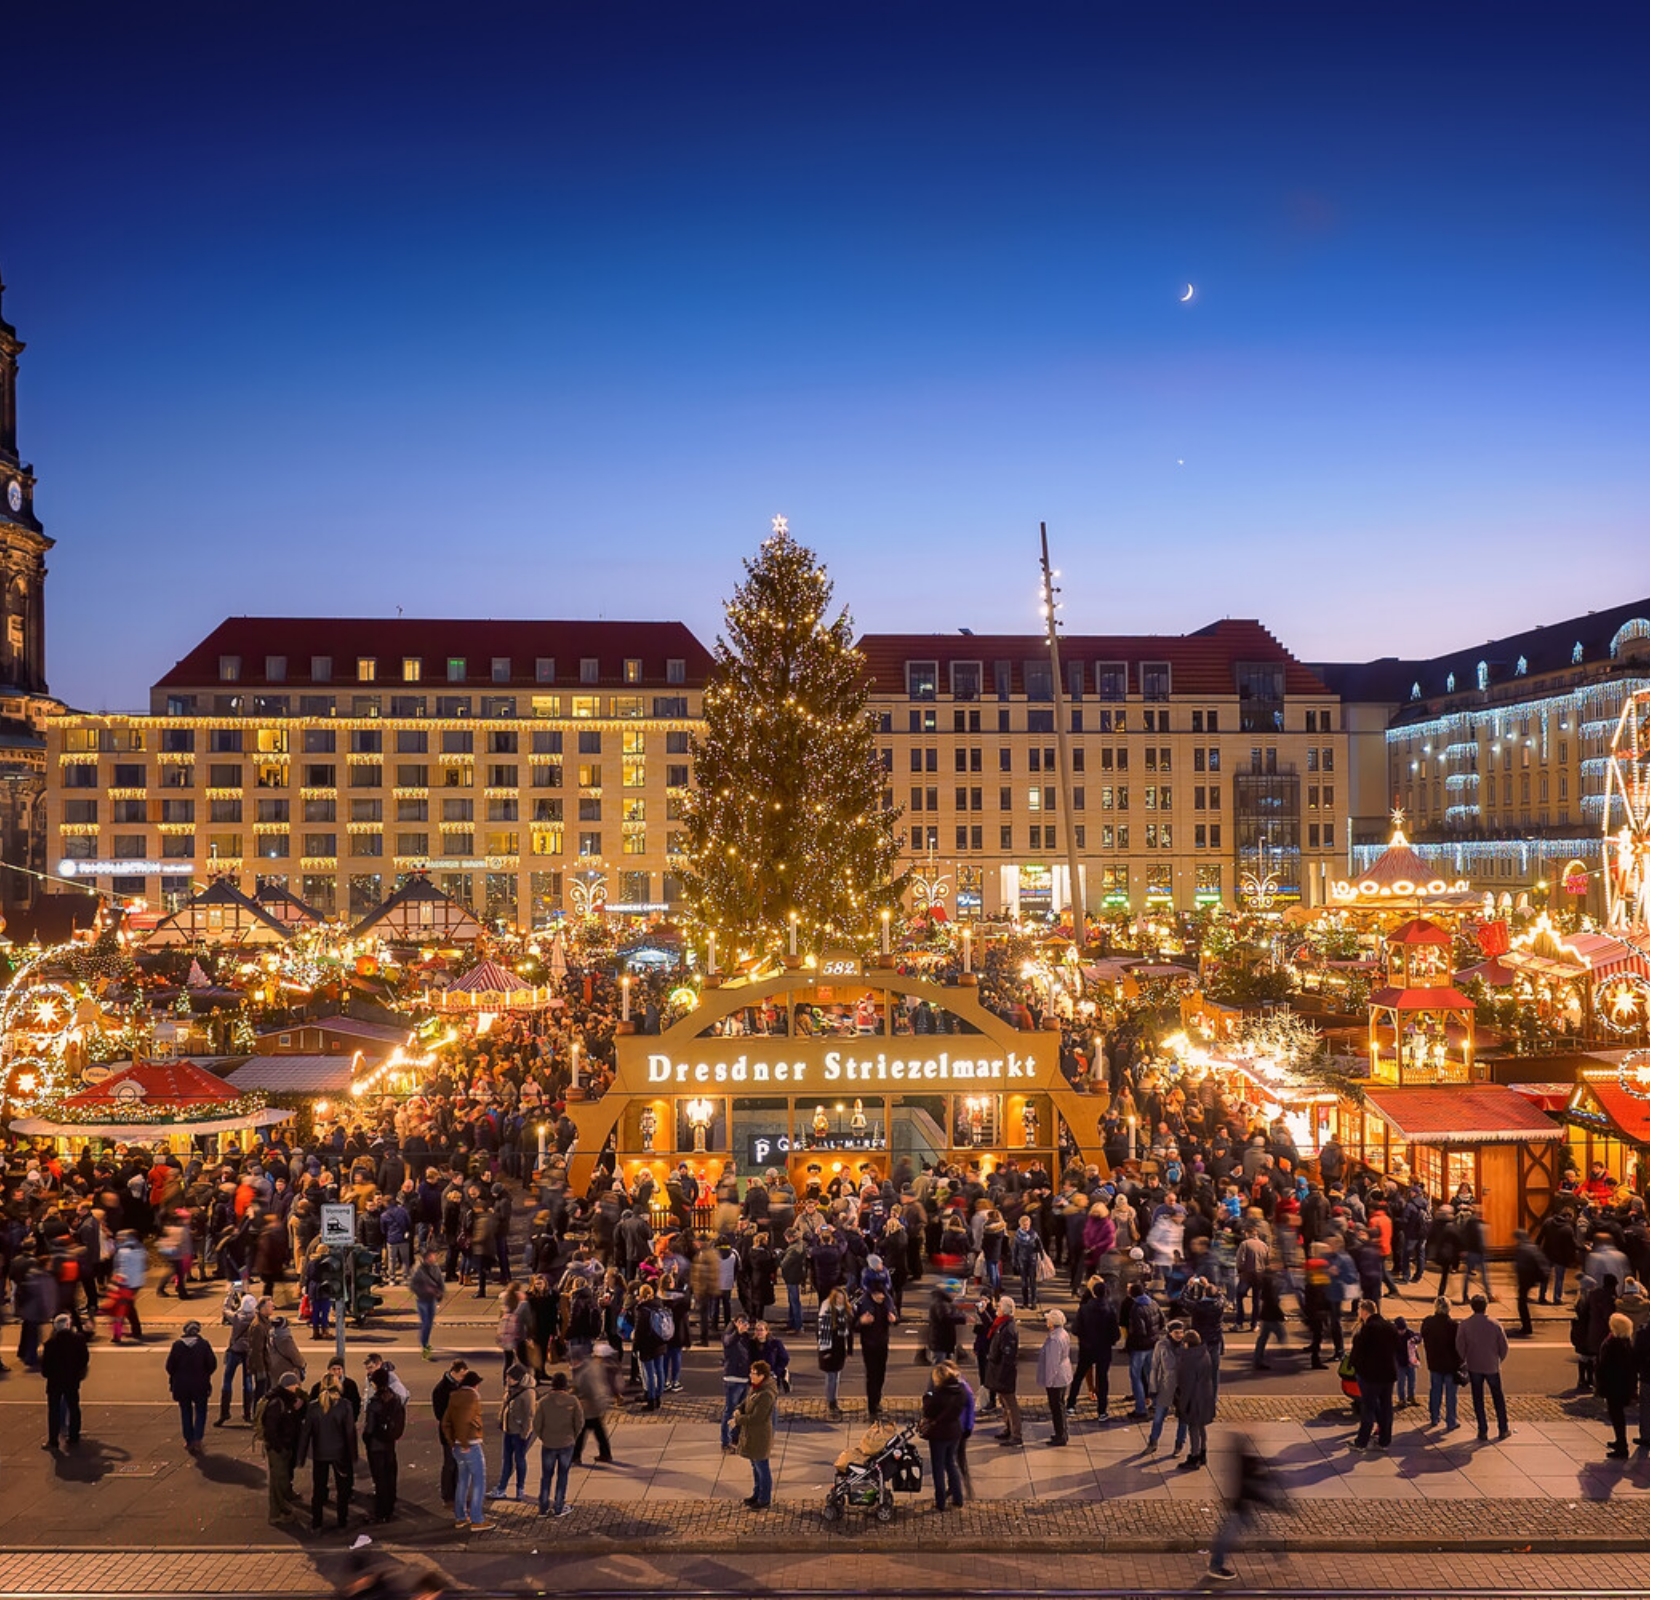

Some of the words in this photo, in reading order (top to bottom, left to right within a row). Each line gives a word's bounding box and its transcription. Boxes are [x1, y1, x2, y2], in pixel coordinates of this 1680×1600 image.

[822, 961, 858, 975] 582.
[648, 1055, 807, 1082] Dresdner
[824, 1052, 1036, 1080] Striezelmarkt
[755, 1143, 770, 1163] P
